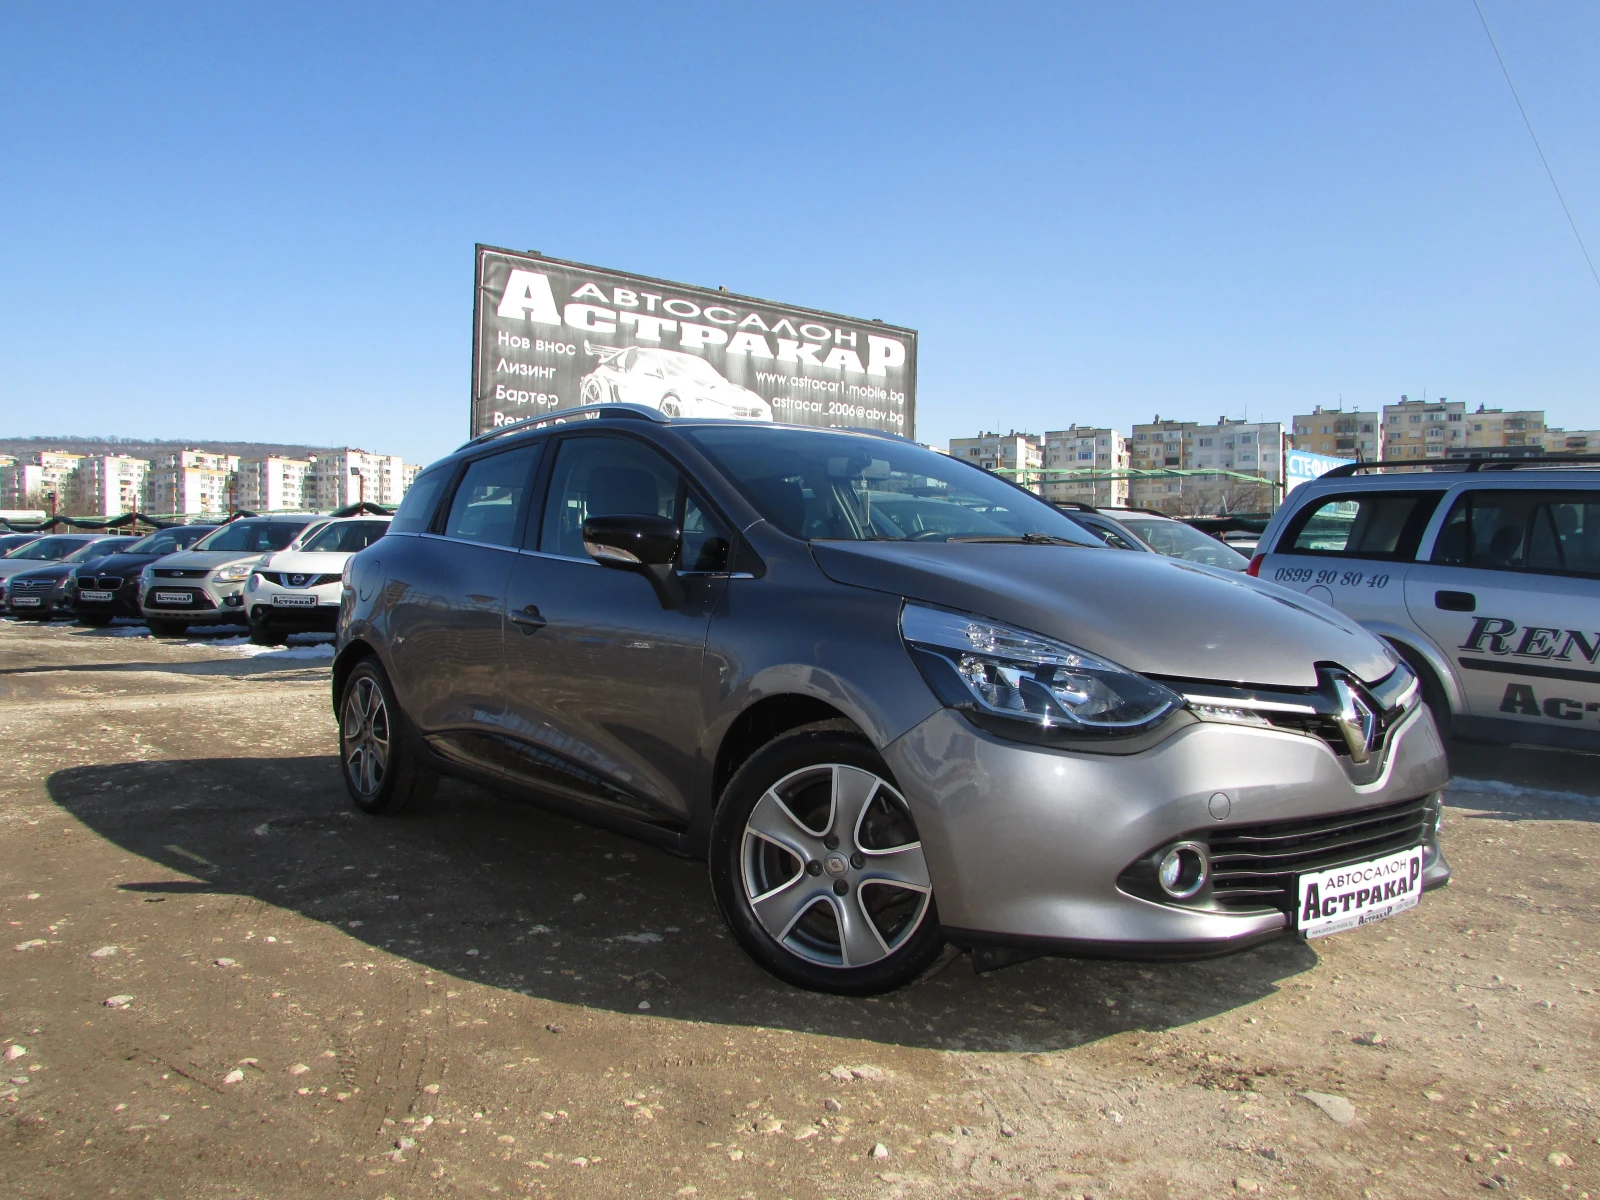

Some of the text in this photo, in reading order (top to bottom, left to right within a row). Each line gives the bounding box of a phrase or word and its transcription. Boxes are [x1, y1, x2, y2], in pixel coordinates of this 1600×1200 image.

[497, 268, 907, 377] АСТРАКАР
[570, 282, 858, 347] АВТОСАЛОН
[497, 330, 577, 356] Нов внос
[496, 357, 557, 379] Лизинг
[495, 384, 559, 408] Бартер
[755, 371, 905, 405] www.astracar1.mobile.bg
[771, 396, 905, 425] astracar_2006@abv.bg
[1274, 567, 1389, 589] 0899 90 80 40
[273, 596, 315, 605] АСТРАКАР
[1325, 858, 1407, 890] АВТОСАЛОН
[1302, 856, 1420, 922] АСТРАКАР
